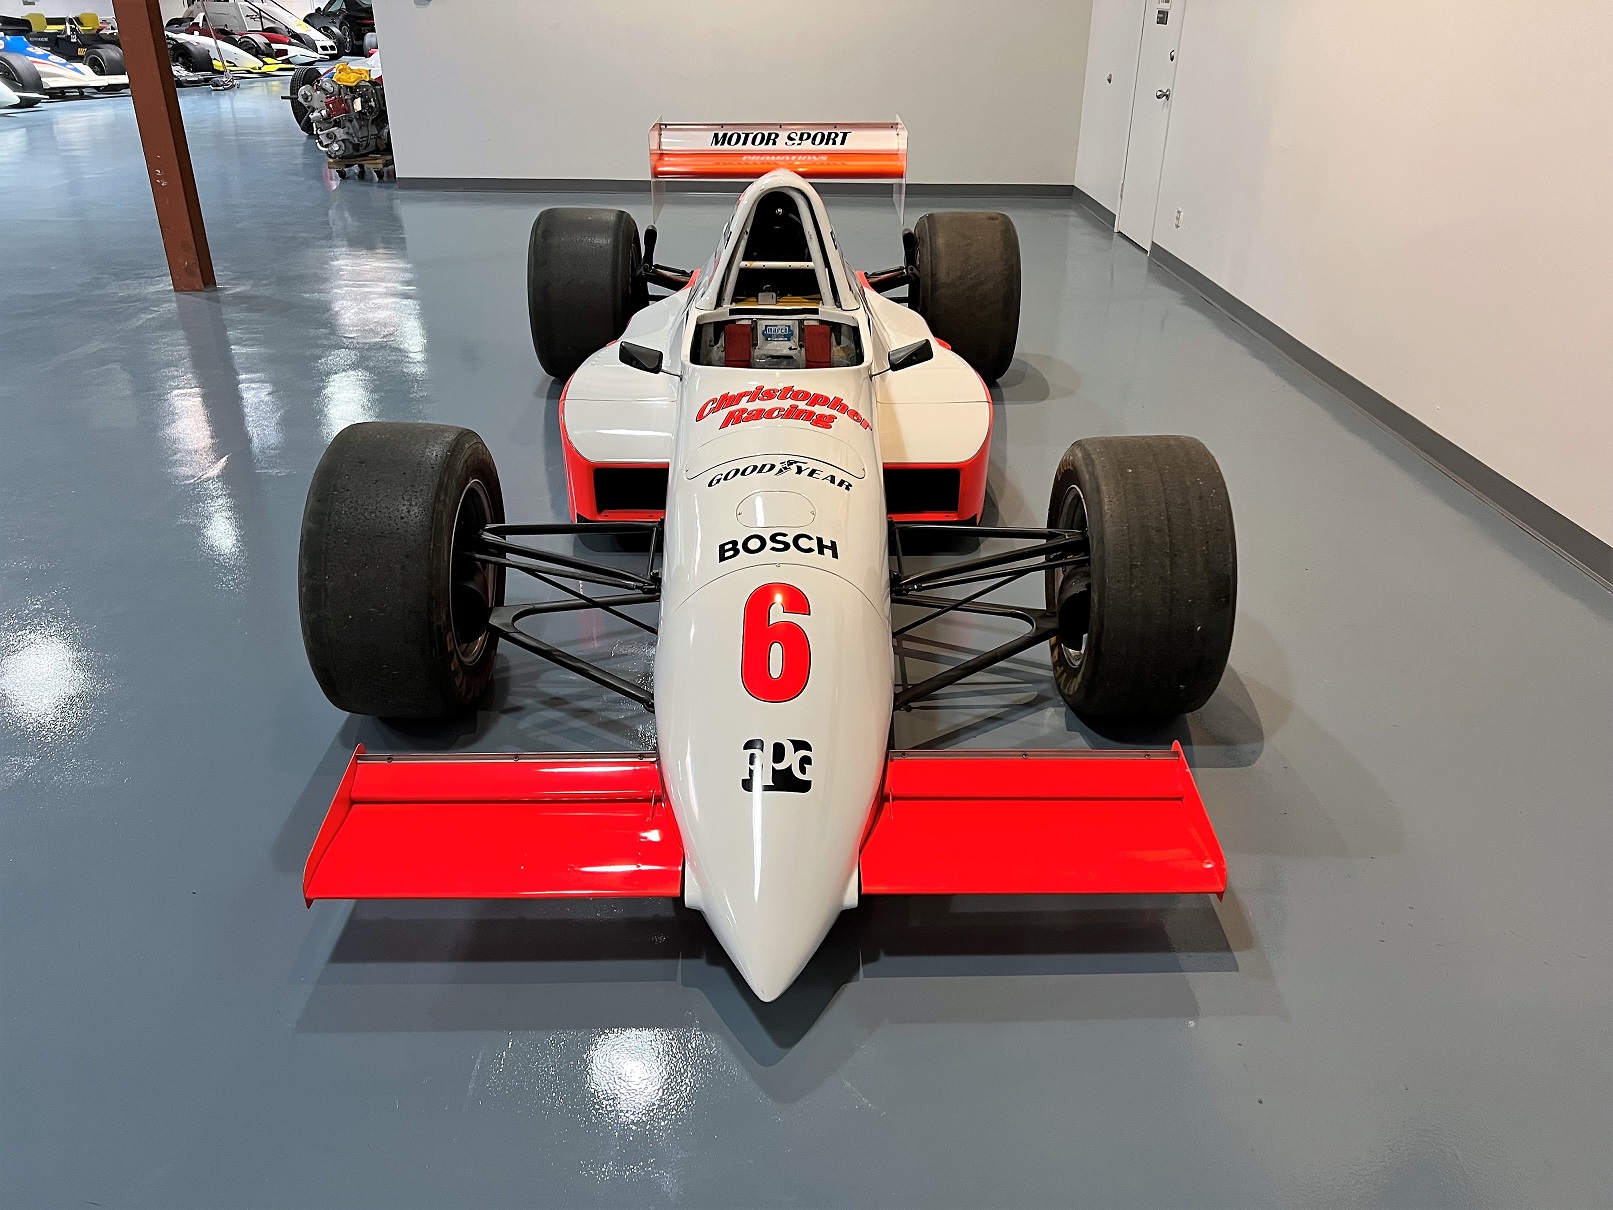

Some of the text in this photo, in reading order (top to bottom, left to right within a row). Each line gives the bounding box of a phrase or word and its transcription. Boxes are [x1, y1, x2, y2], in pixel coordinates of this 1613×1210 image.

[711, 131, 852, 146] MOTOR SPORT
[695, 385, 873, 431] Christopher
[719, 404, 838, 430] Racing
[718, 532, 839, 563] BOSCH
[741, 582, 811, 703] 6
[741, 738, 813, 793] PPG
